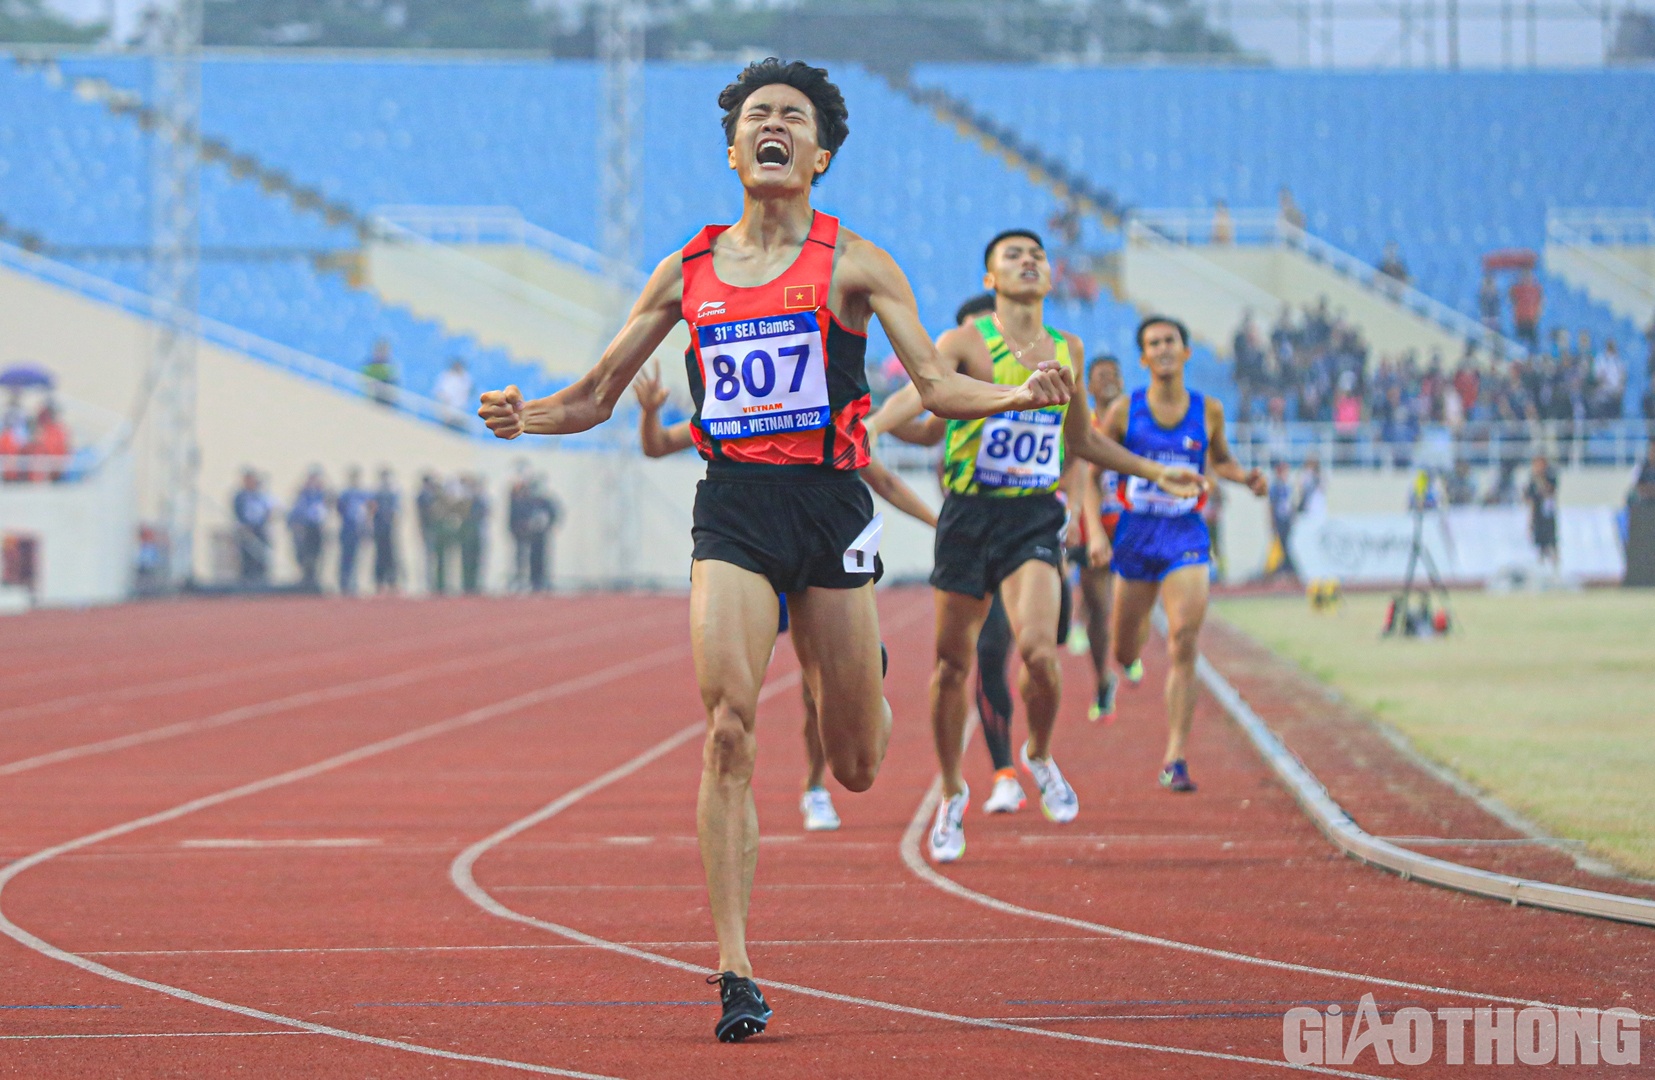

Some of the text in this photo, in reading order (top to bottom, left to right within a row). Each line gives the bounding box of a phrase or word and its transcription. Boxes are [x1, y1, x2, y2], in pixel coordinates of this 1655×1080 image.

[697, 308, 727, 319] LI-NING
[735, 322, 757, 339] SEA
[759, 319, 796, 335] Games
[712, 344, 810, 401] 807
[742, 403, 783, 414] VIETNAM
[710, 420, 741, 436] HANOI
[748, 414, 794, 433] VIETNAM
[795, 411, 821, 428] 2022
[986, 428, 1055, 465] 805
